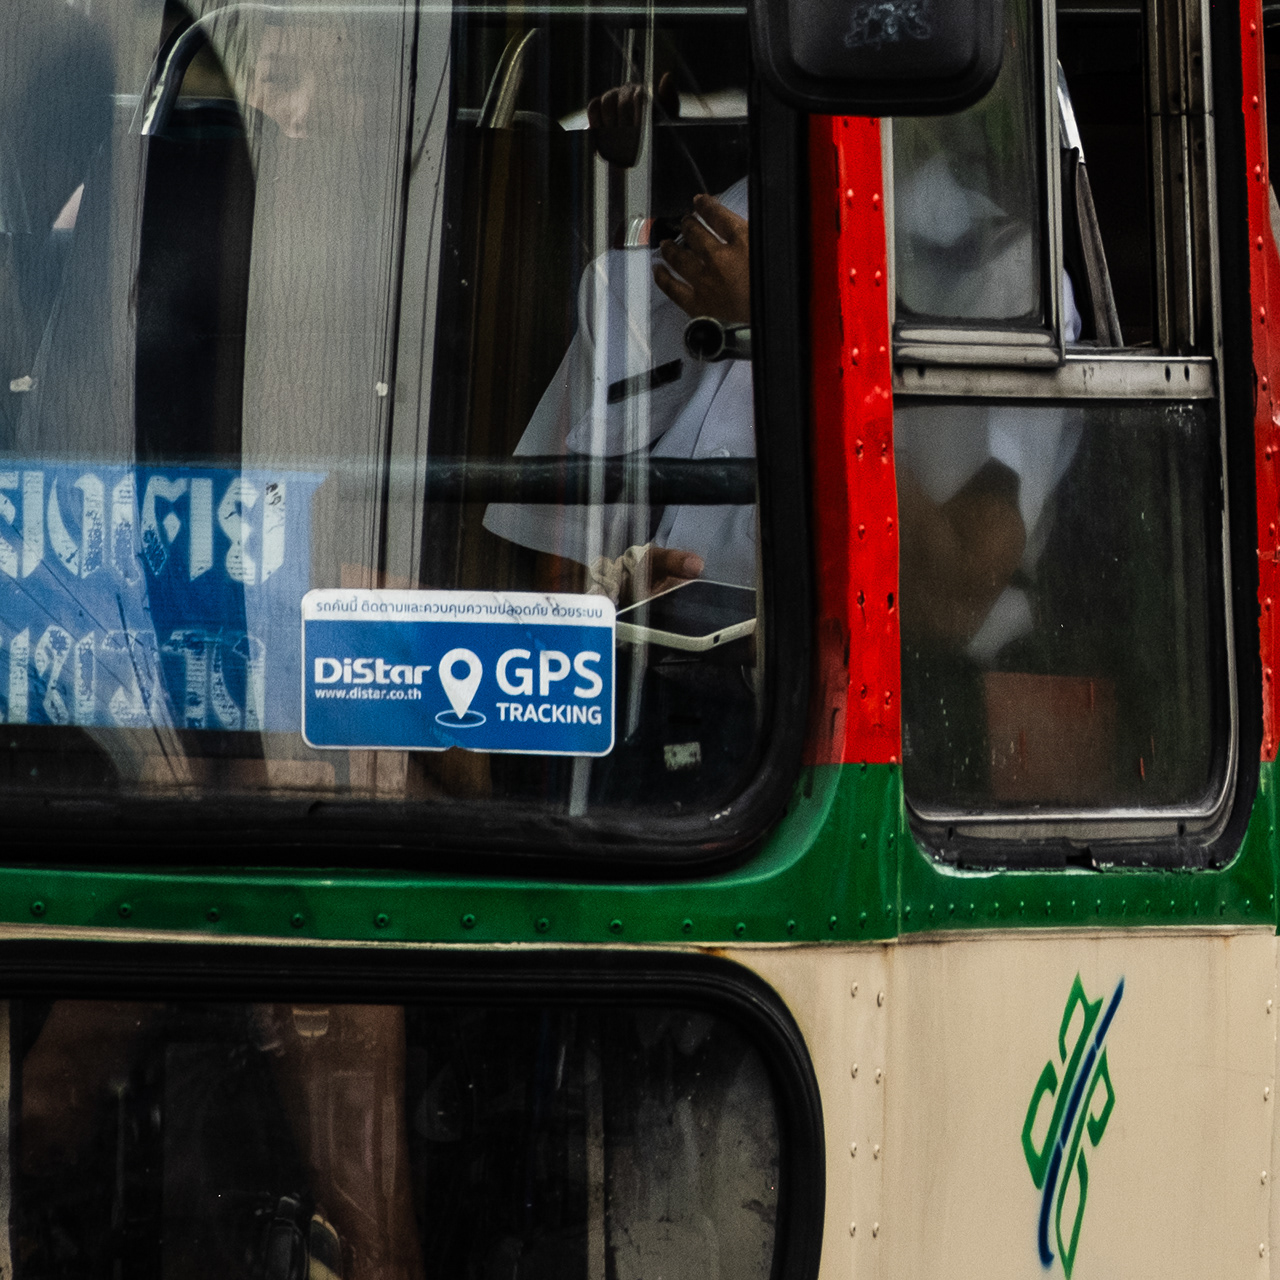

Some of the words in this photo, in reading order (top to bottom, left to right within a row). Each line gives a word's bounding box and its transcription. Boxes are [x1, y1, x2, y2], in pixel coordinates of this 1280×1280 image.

[316, 595, 358, 613] รถคันนี้
[314, 657, 433, 685] DiStar
[495, 647, 604, 699] GPS
[315, 687, 422, 701] www.distar.co.th
[496, 702, 602, 725] TRACKING
